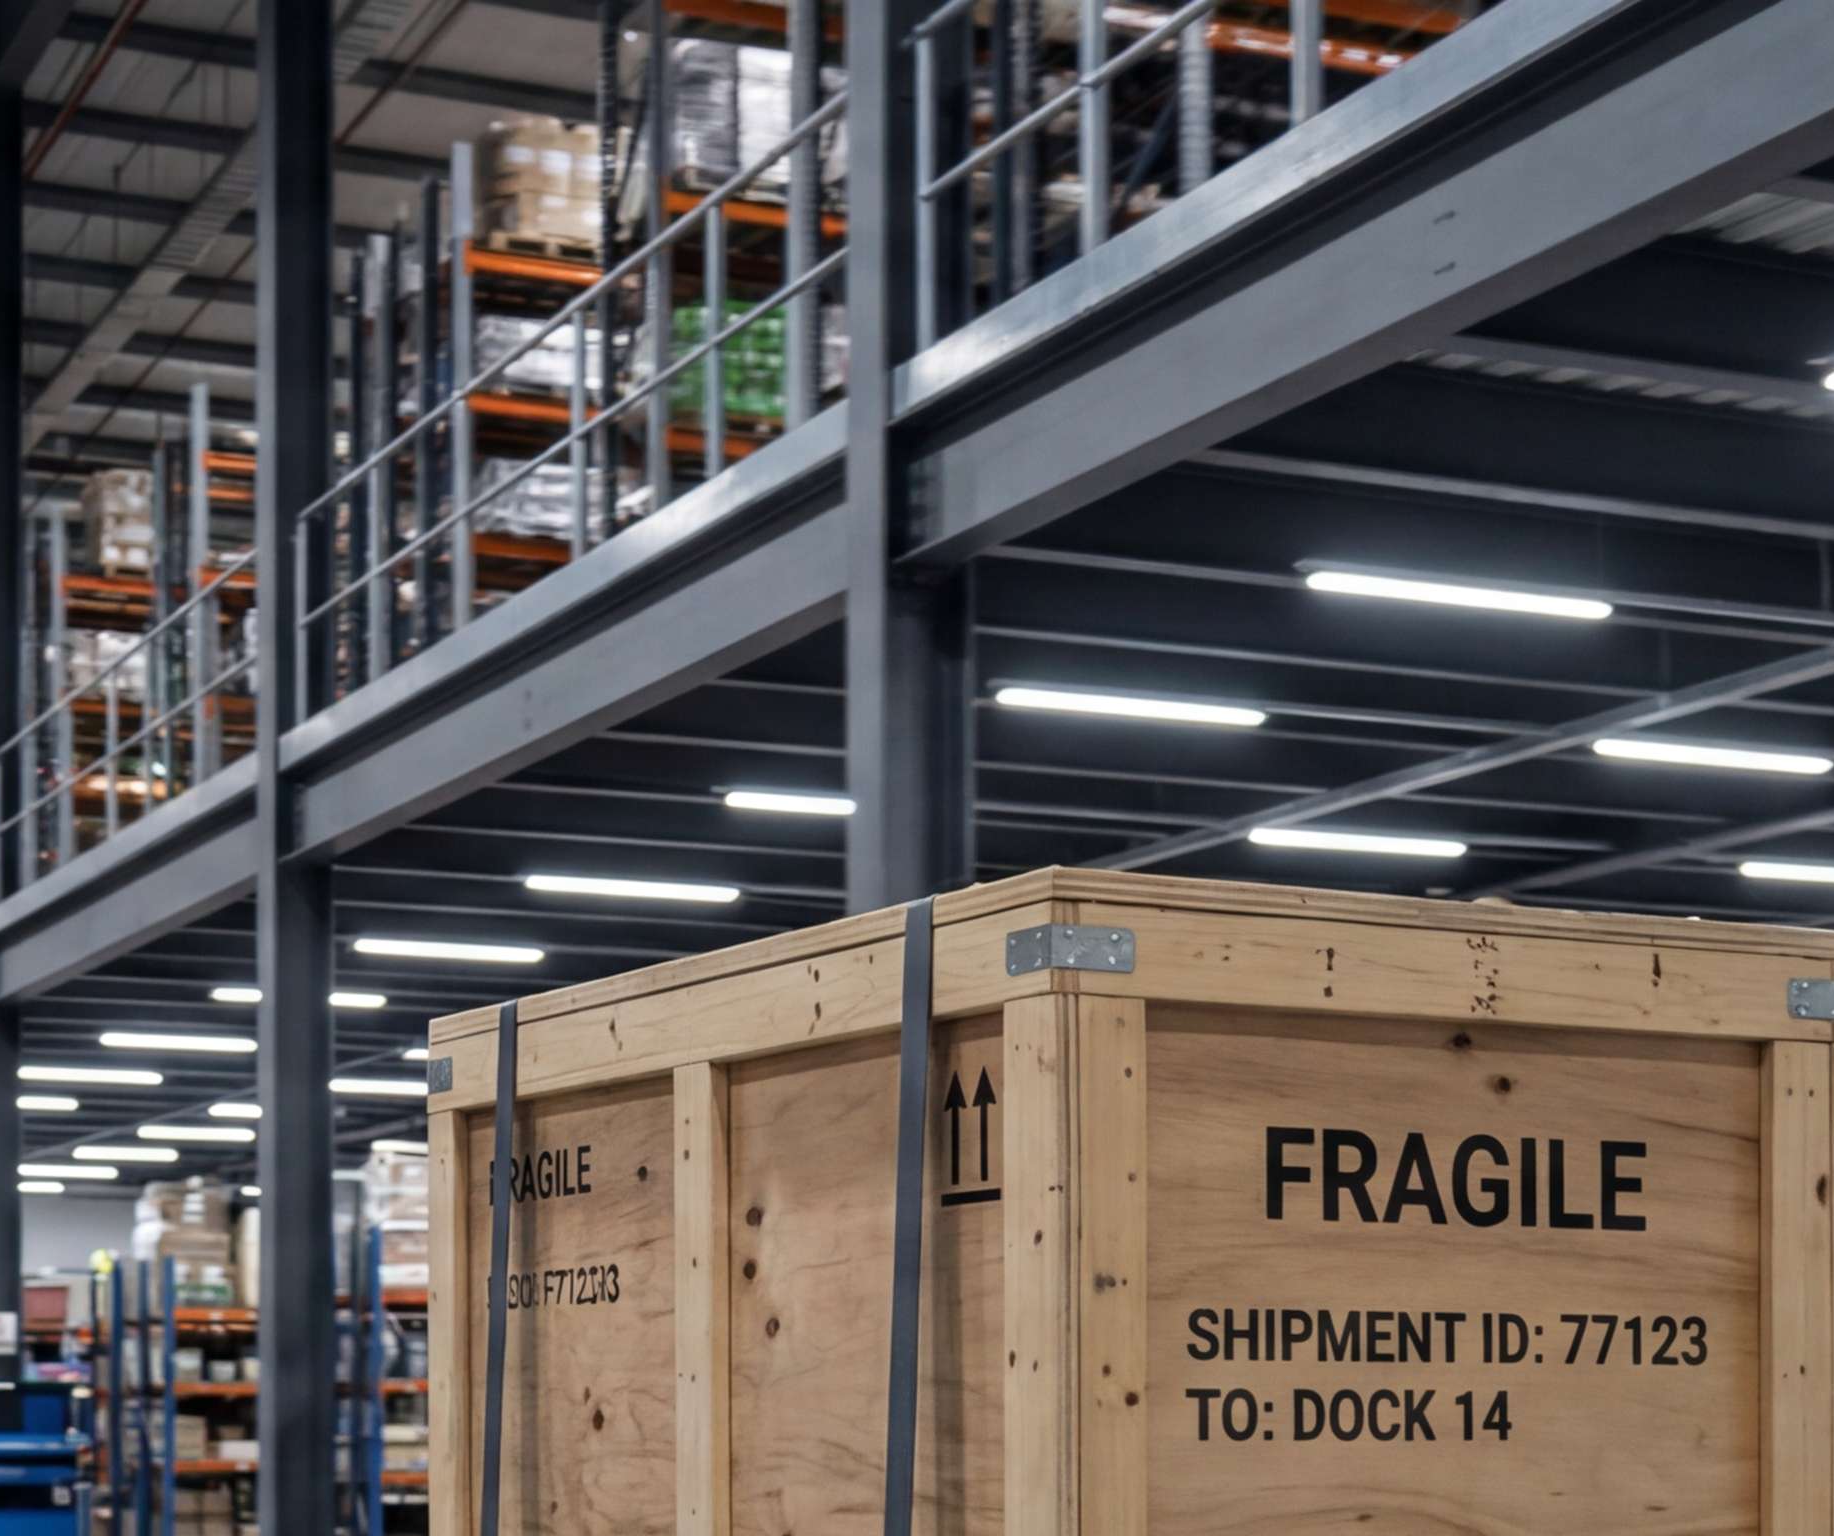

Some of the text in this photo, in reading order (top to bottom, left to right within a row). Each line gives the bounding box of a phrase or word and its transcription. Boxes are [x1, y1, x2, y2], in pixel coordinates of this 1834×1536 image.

[489, 1145, 591, 1206] RAGILE
[1265, 1126, 1647, 1231] FRAGILE
[1186, 1308, 1708, 1366] SHIPMENT ID: 77123
[1185, 1388, 1512, 1441] TO: DOCK 14
